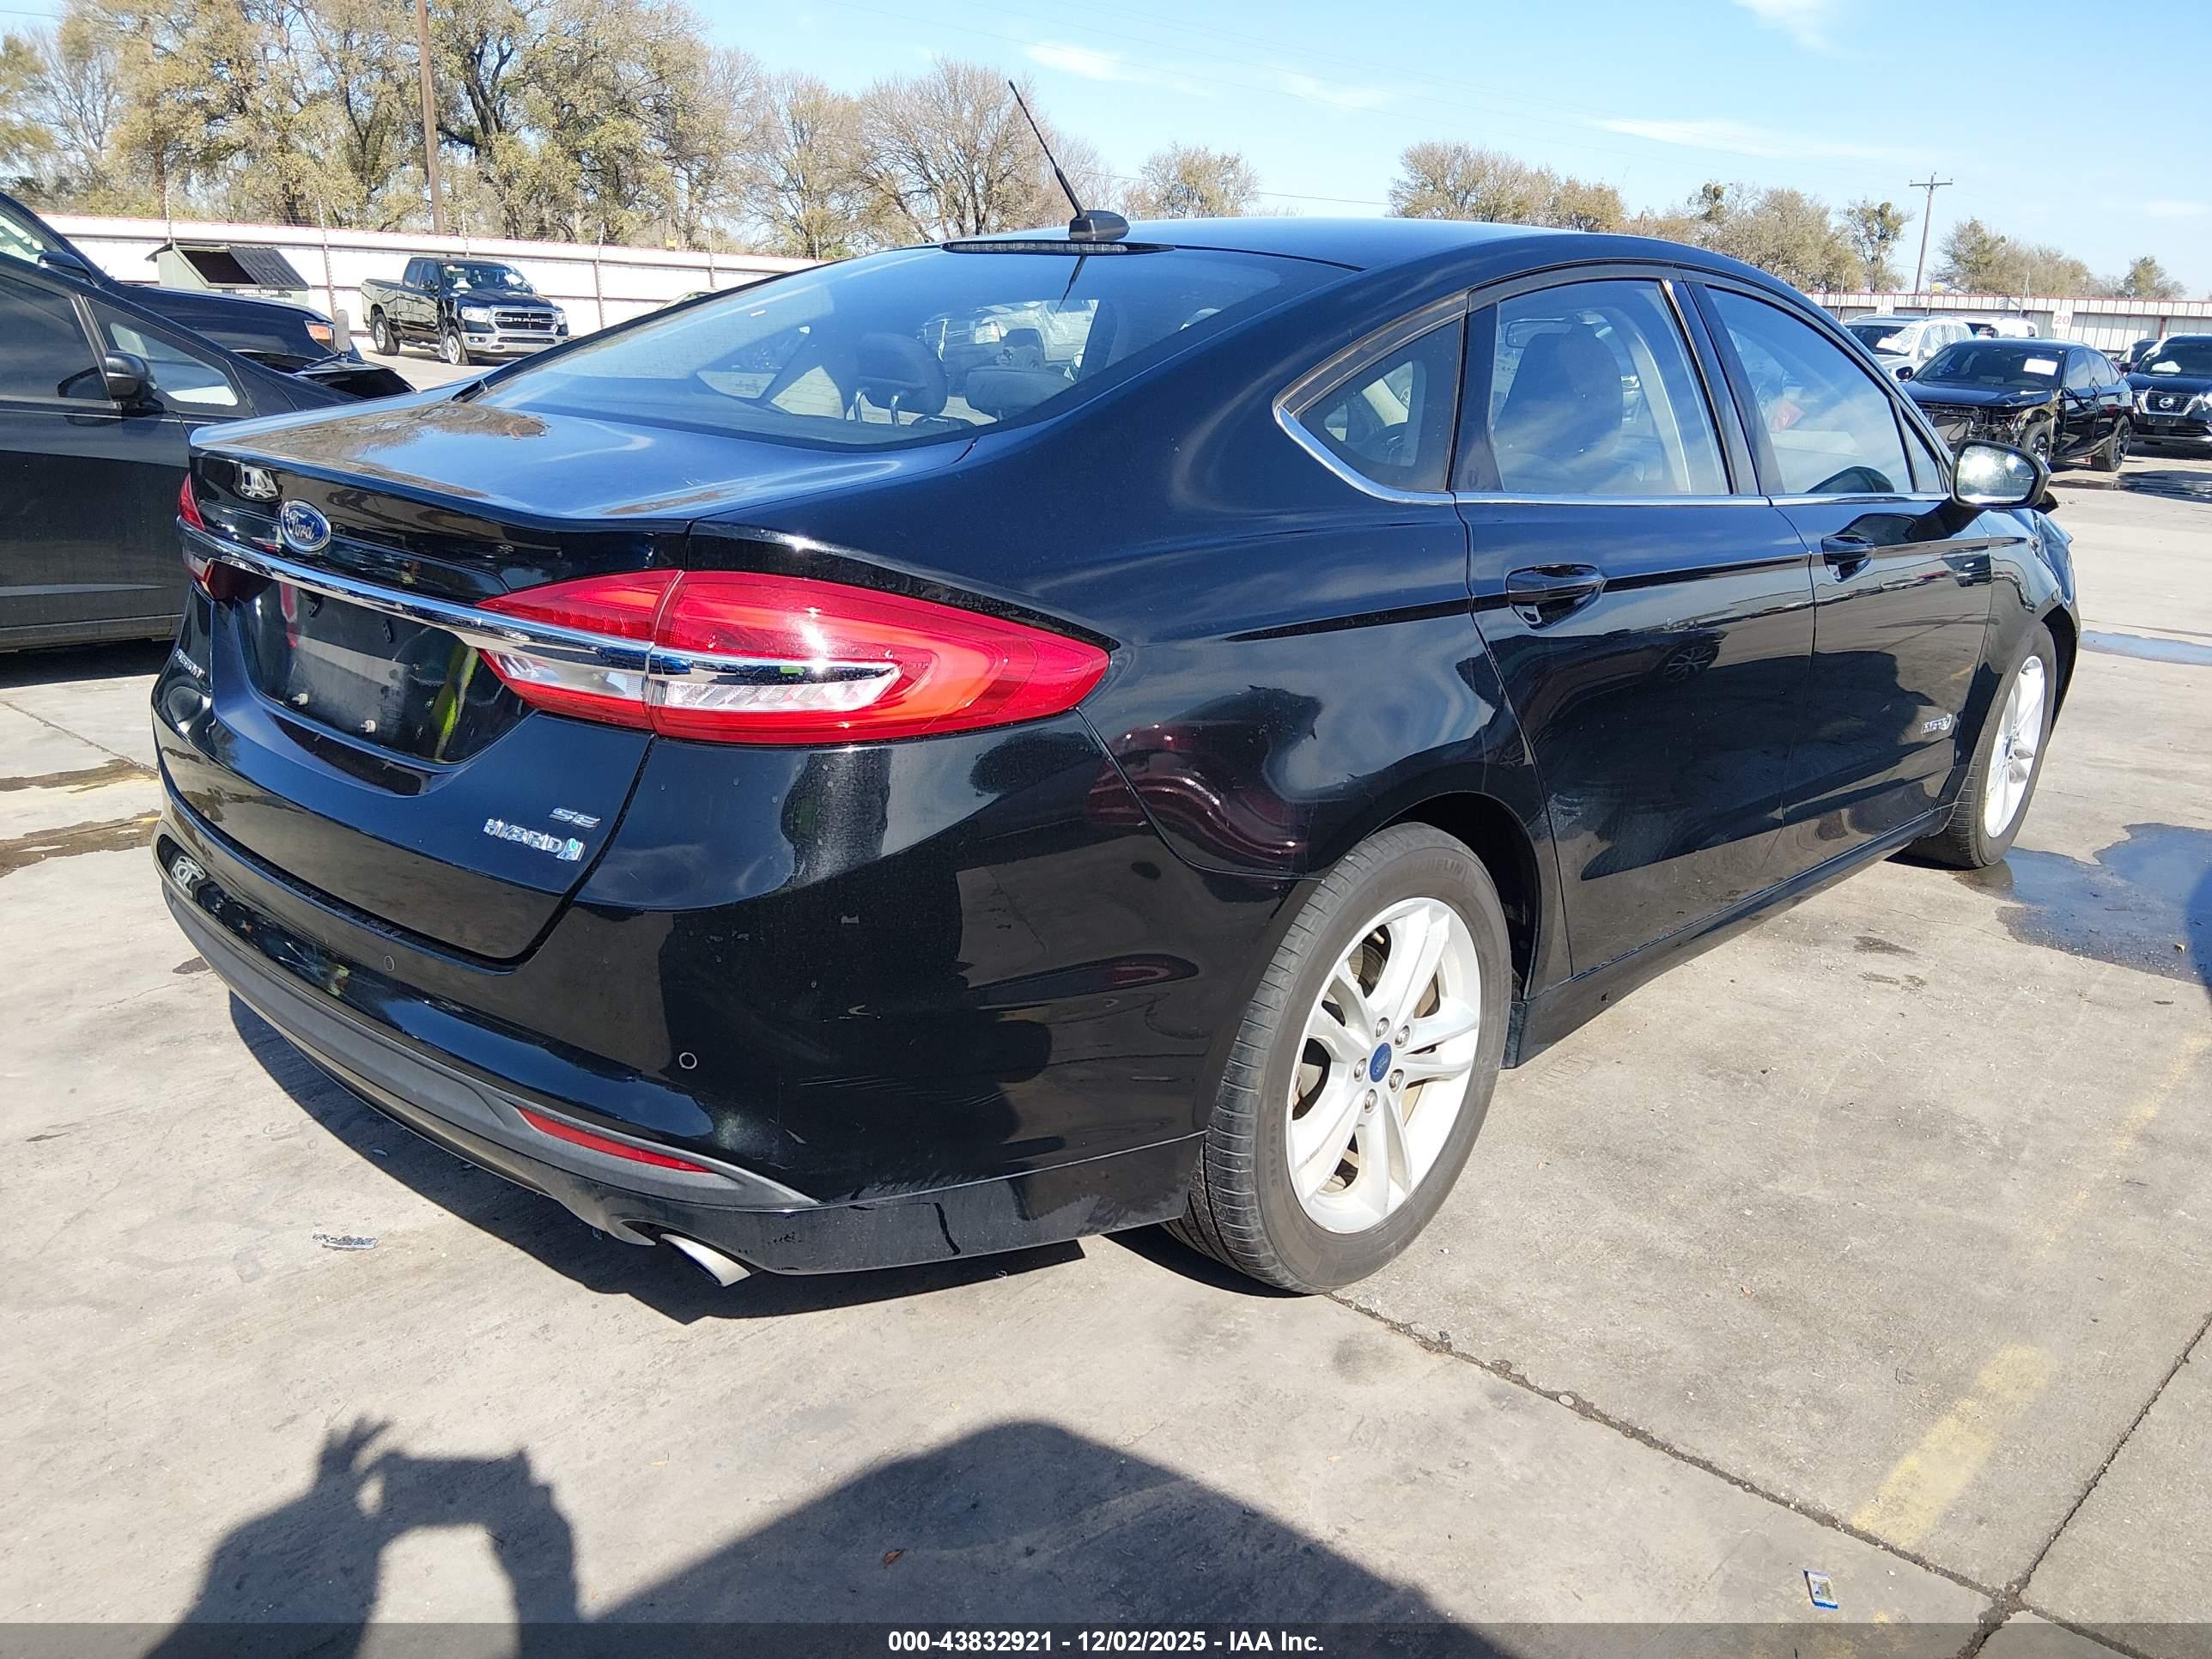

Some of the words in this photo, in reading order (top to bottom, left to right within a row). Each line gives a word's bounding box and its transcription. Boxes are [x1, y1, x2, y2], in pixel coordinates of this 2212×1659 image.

[2054, 315, 2070, 325] 20
[288, 510, 315, 540] Ford
[549, 807, 601, 830] SE
[483, 818, 563, 854] HYBRID
